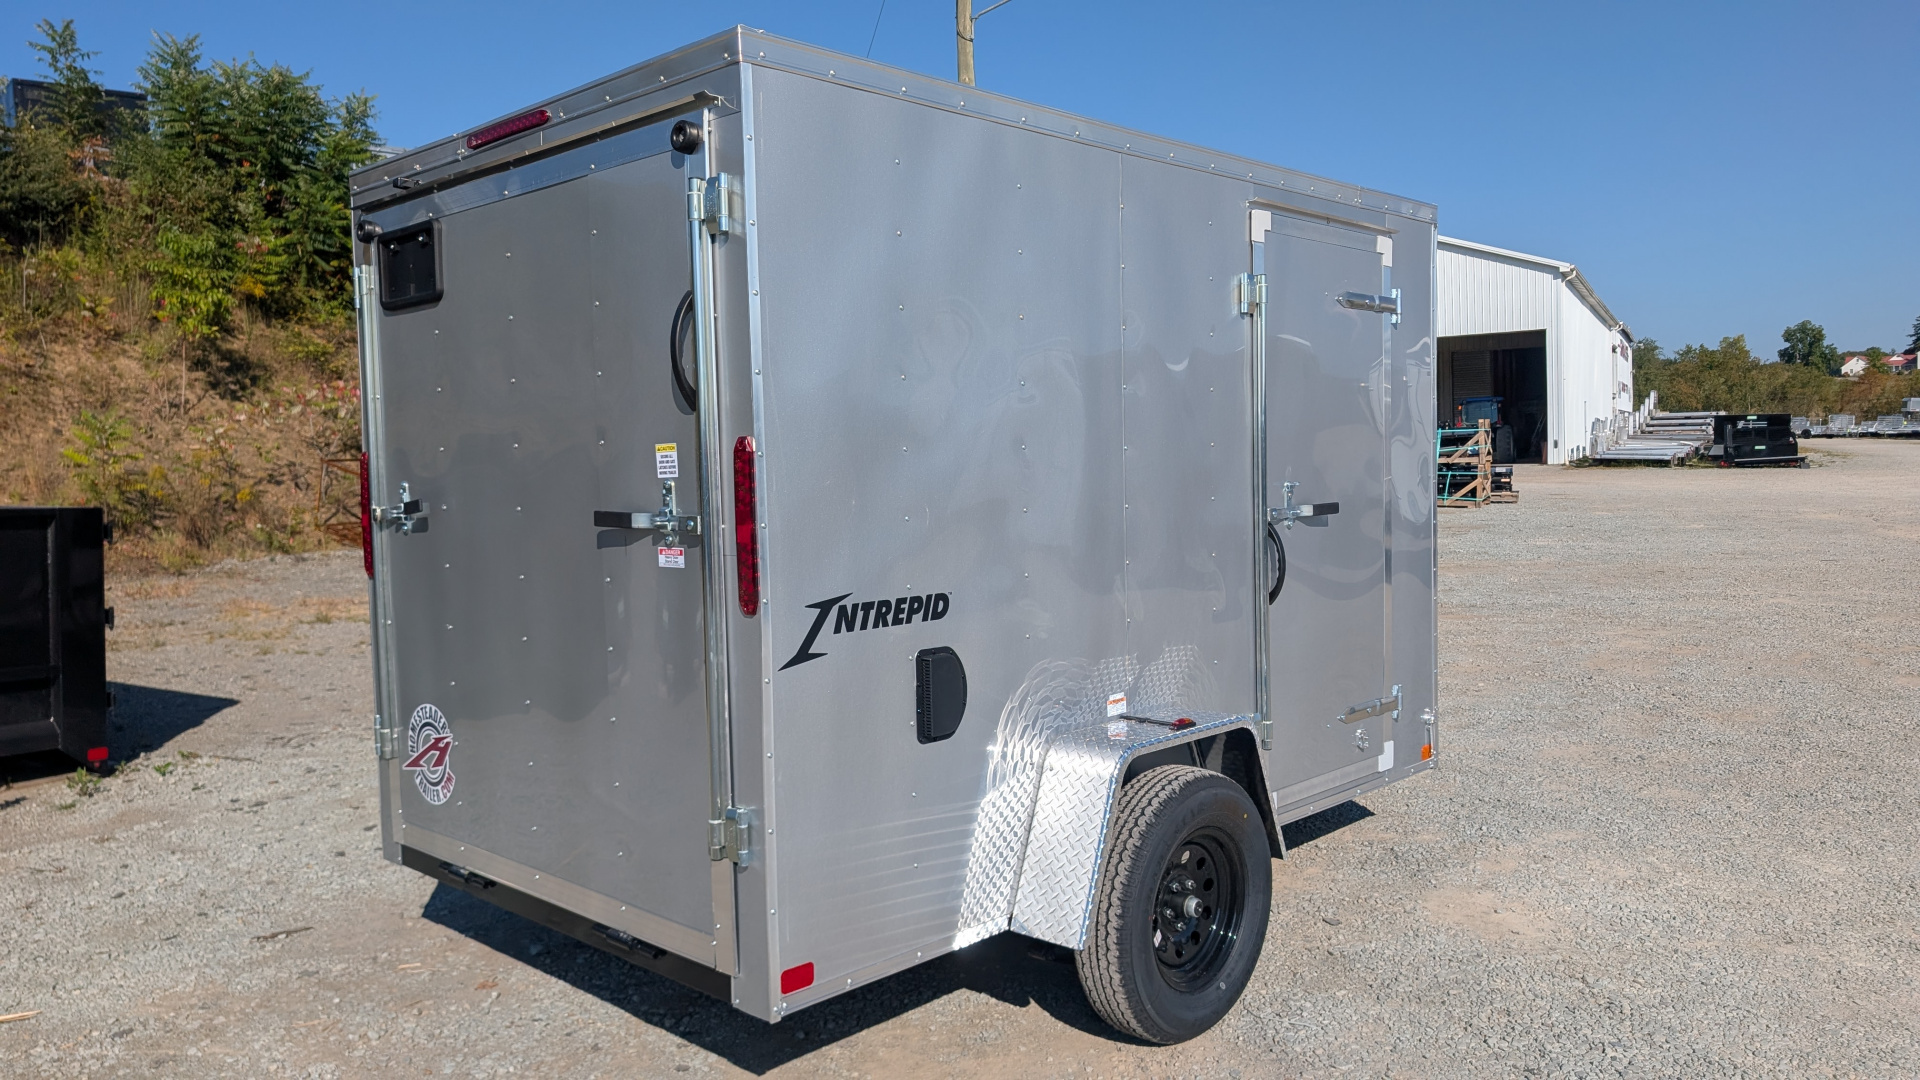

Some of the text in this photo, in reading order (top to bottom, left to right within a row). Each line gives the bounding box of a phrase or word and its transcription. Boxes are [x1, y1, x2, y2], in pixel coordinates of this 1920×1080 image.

[777, 592, 950, 672] INTREPID
[409, 705, 449, 754] HOMESTEADER
[415, 769, 455, 803] TRAILER.COM
